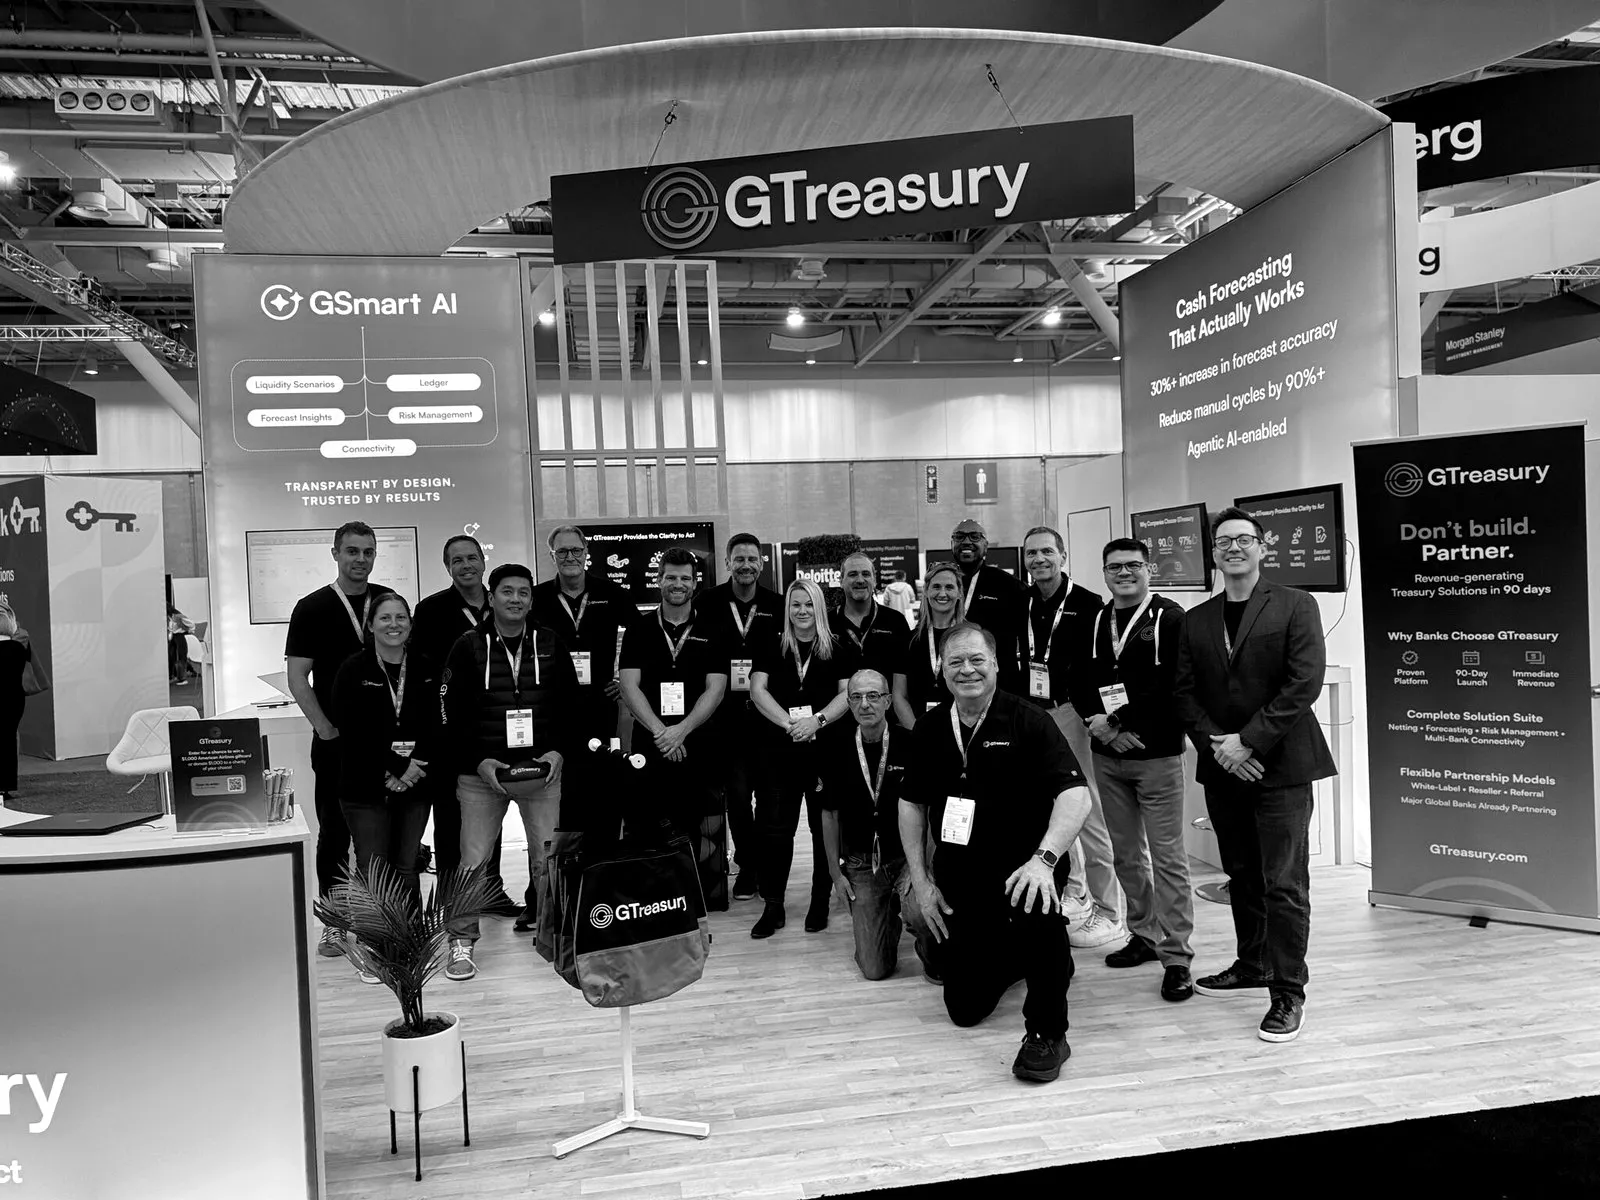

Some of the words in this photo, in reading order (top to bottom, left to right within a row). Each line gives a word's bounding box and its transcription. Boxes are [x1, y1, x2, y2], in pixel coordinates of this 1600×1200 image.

[725, 162, 1030, 229] GTreasury
[1418, 246, 1440, 275] g
[1176, 291, 1206, 319] Cash
[1210, 253, 1292, 305] Forecasting
[309, 291, 421, 315] GSmart
[432, 293, 457, 314] AI
[1169, 327, 1196, 350] That
[1198, 302, 1251, 339] Actually
[1255, 279, 1305, 315] Works
[1446, 336, 1474, 351] Morgan
[1475, 327, 1505, 342] Stanley
[1150, 378, 1177, 397] 30%+
[1179, 367, 1219, 387] increase
[1220, 359, 1230, 372] in
[1232, 341, 1277, 370] forecast
[1280, 319, 1338, 353] accuracy
[255, 381, 291, 390] Liquidity
[293, 380, 335, 389] Scenarios
[419, 379, 448, 388] Ledger
[1159, 411, 1192, 428] Reduce
[1194, 395, 1230, 419] manual
[1232, 387, 1266, 411] cycles
[1268, 381, 1283, 401] by
[1285, 367, 1326, 392] 90%+
[261, 414, 298, 422] Forecast
[300, 413, 332, 423] Insights
[399, 411, 416, 419] Risk
[418, 411, 473, 420] Management
[1187, 435, 1224, 459] Agentic
[1226, 417, 1287, 447] AI-enabled
[342, 444, 395, 454] Connectivity
[1427, 465, 1550, 486] GTreasury
[285, 480, 379, 492] TRANSPARENT
[382, 480, 398, 488] BY
[403, 478, 455, 489] DESIGN,
[302, 495, 360, 506] TRUSTED
[365, 494, 380, 503] BY
[386, 493, 440, 503] RESULTS
[1400, 522, 1462, 540] Don't
[1470, 517, 1536, 538] build.
[1422, 545, 1514, 561] Partner.
[796, 568, 841, 583] Deloitte
[1414, 572, 1524, 583] Revenue-generating
[1391, 588, 1435, 598] Treasury
[1438, 586, 1487, 596] Solutions
[1490, 586, 1500, 594] in
[1503, 585, 1520, 594] 90
[1523, 584, 1551, 595] days
[1388, 632, 1412, 642] Why
[1415, 632, 1449, 641] Banks
[1451, 631, 1495, 641] Choose
[1497, 631, 1559, 642] GTreasury
[1455, 670, 1488, 678] 90-Day
[1512, 670, 1559, 678] Immediate
[1407, 710, 1461, 721] Complete
[1463, 712, 1510, 722] Solution
[1513, 713, 1543, 723] Suite
[1388, 724, 1418, 732] Netting
[1426, 725, 1473, 735] Forecasting
[1501, 727, 1559, 737] Management
[1425, 735, 1469, 743] Multi-Bank
[1471, 737, 1525, 747] Connectivity
[1400, 767, 1441, 778] Flexible
[1444, 770, 1509, 784] Partnership
[1513, 774, 1556, 785] Models
[1411, 782, 1460, 792] White-Label
[1469, 786, 1501, 795] Reseller
[1510, 789, 1544, 797] Referral
[1401, 796, 1422, 805] Major
[1425, 798, 1450, 807] Global
[1453, 800, 1476, 809] Banks
[1478, 802, 1510, 813] Already
[1512, 805, 1556, 815] Partnering
[1430, 844, 1528, 863] GTreasury.com
[615, 896, 687, 920] GTreasury
